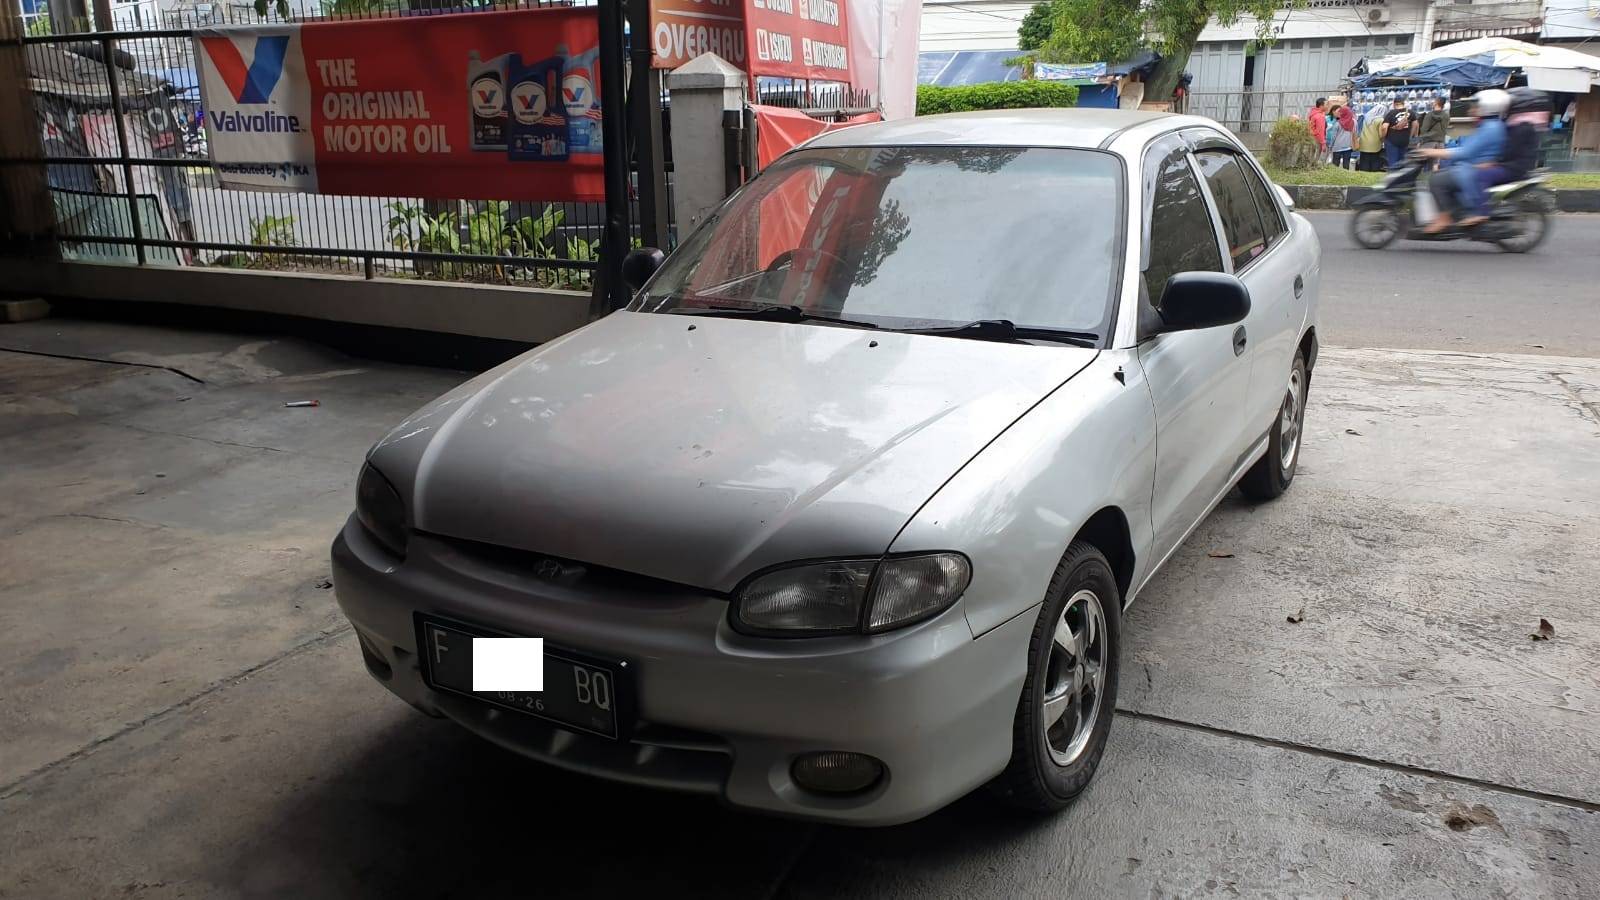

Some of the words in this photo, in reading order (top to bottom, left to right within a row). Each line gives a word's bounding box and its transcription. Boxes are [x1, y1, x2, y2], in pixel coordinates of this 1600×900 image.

[769, 32, 793, 63] ISUZU
[316, 58, 358, 87] THE
[322, 90, 431, 120] ORIGINAL
[210, 110, 301, 133] Valvoline
[323, 124, 408, 153] MOTOR
[413, 124, 452, 153] OIL
[265, 164, 277, 178] by
[432, 629, 449, 664] F
[574, 665, 611, 711] BQ
